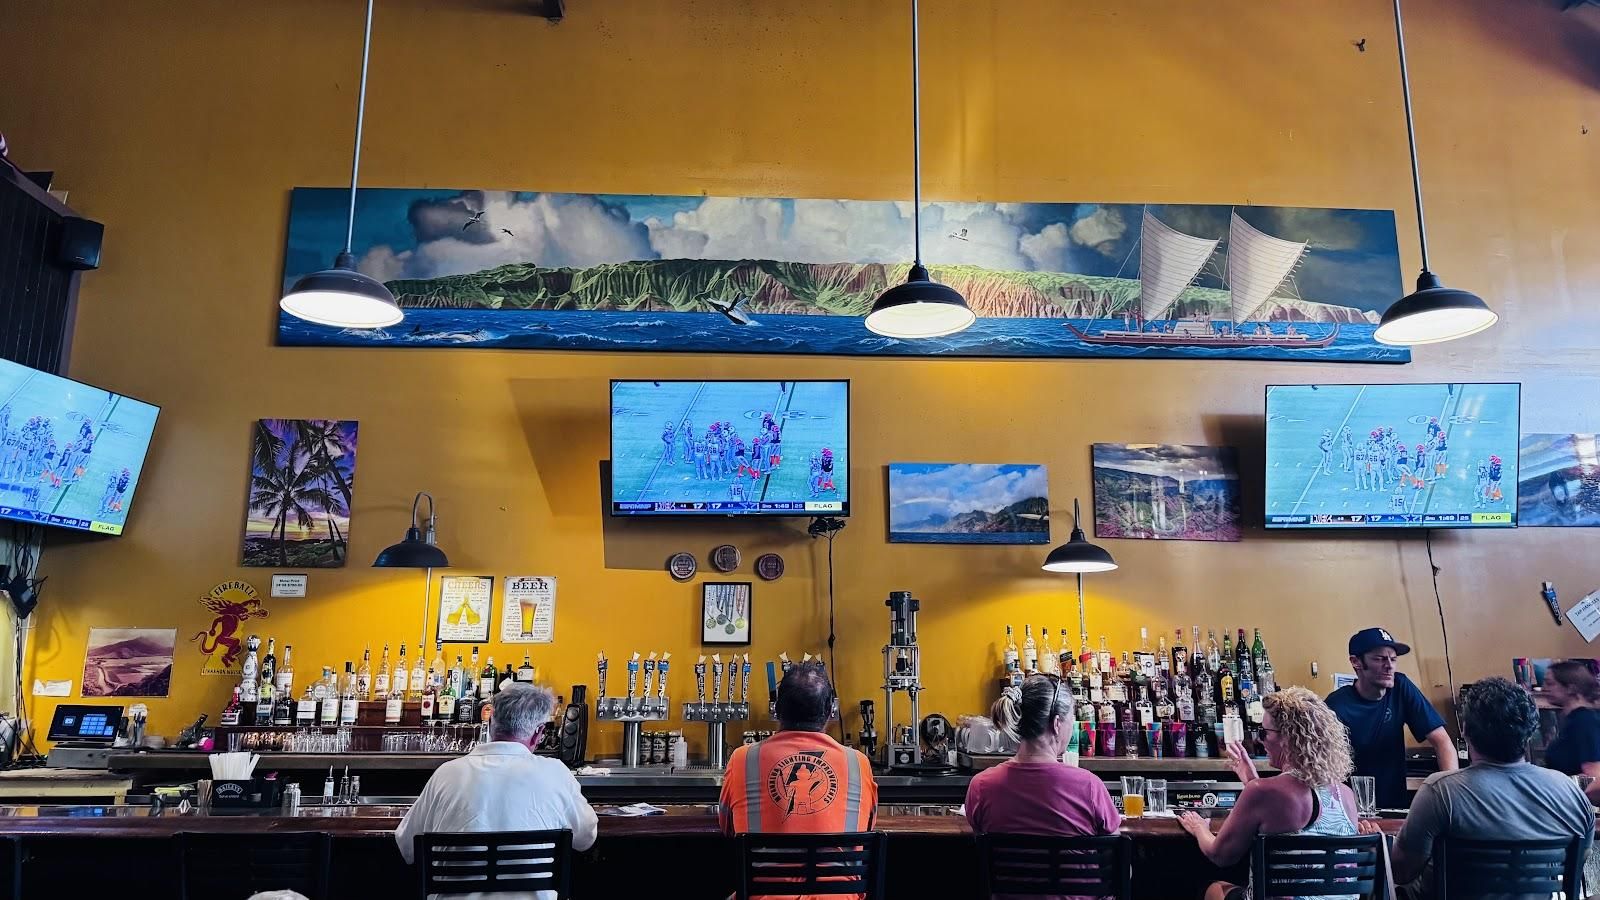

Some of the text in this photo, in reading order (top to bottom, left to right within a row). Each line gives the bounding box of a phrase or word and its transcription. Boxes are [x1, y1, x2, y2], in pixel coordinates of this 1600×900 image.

[214, 581, 255, 597] FIREBALL
[448, 581, 487, 589] CHEERS
[1379, 629, 1392, 641] LA
[778, 755, 810, 768] LIGHTING
[813, 757, 837, 803] IMPROVEMENTS
[218, 784, 240, 793] BAILEYS
